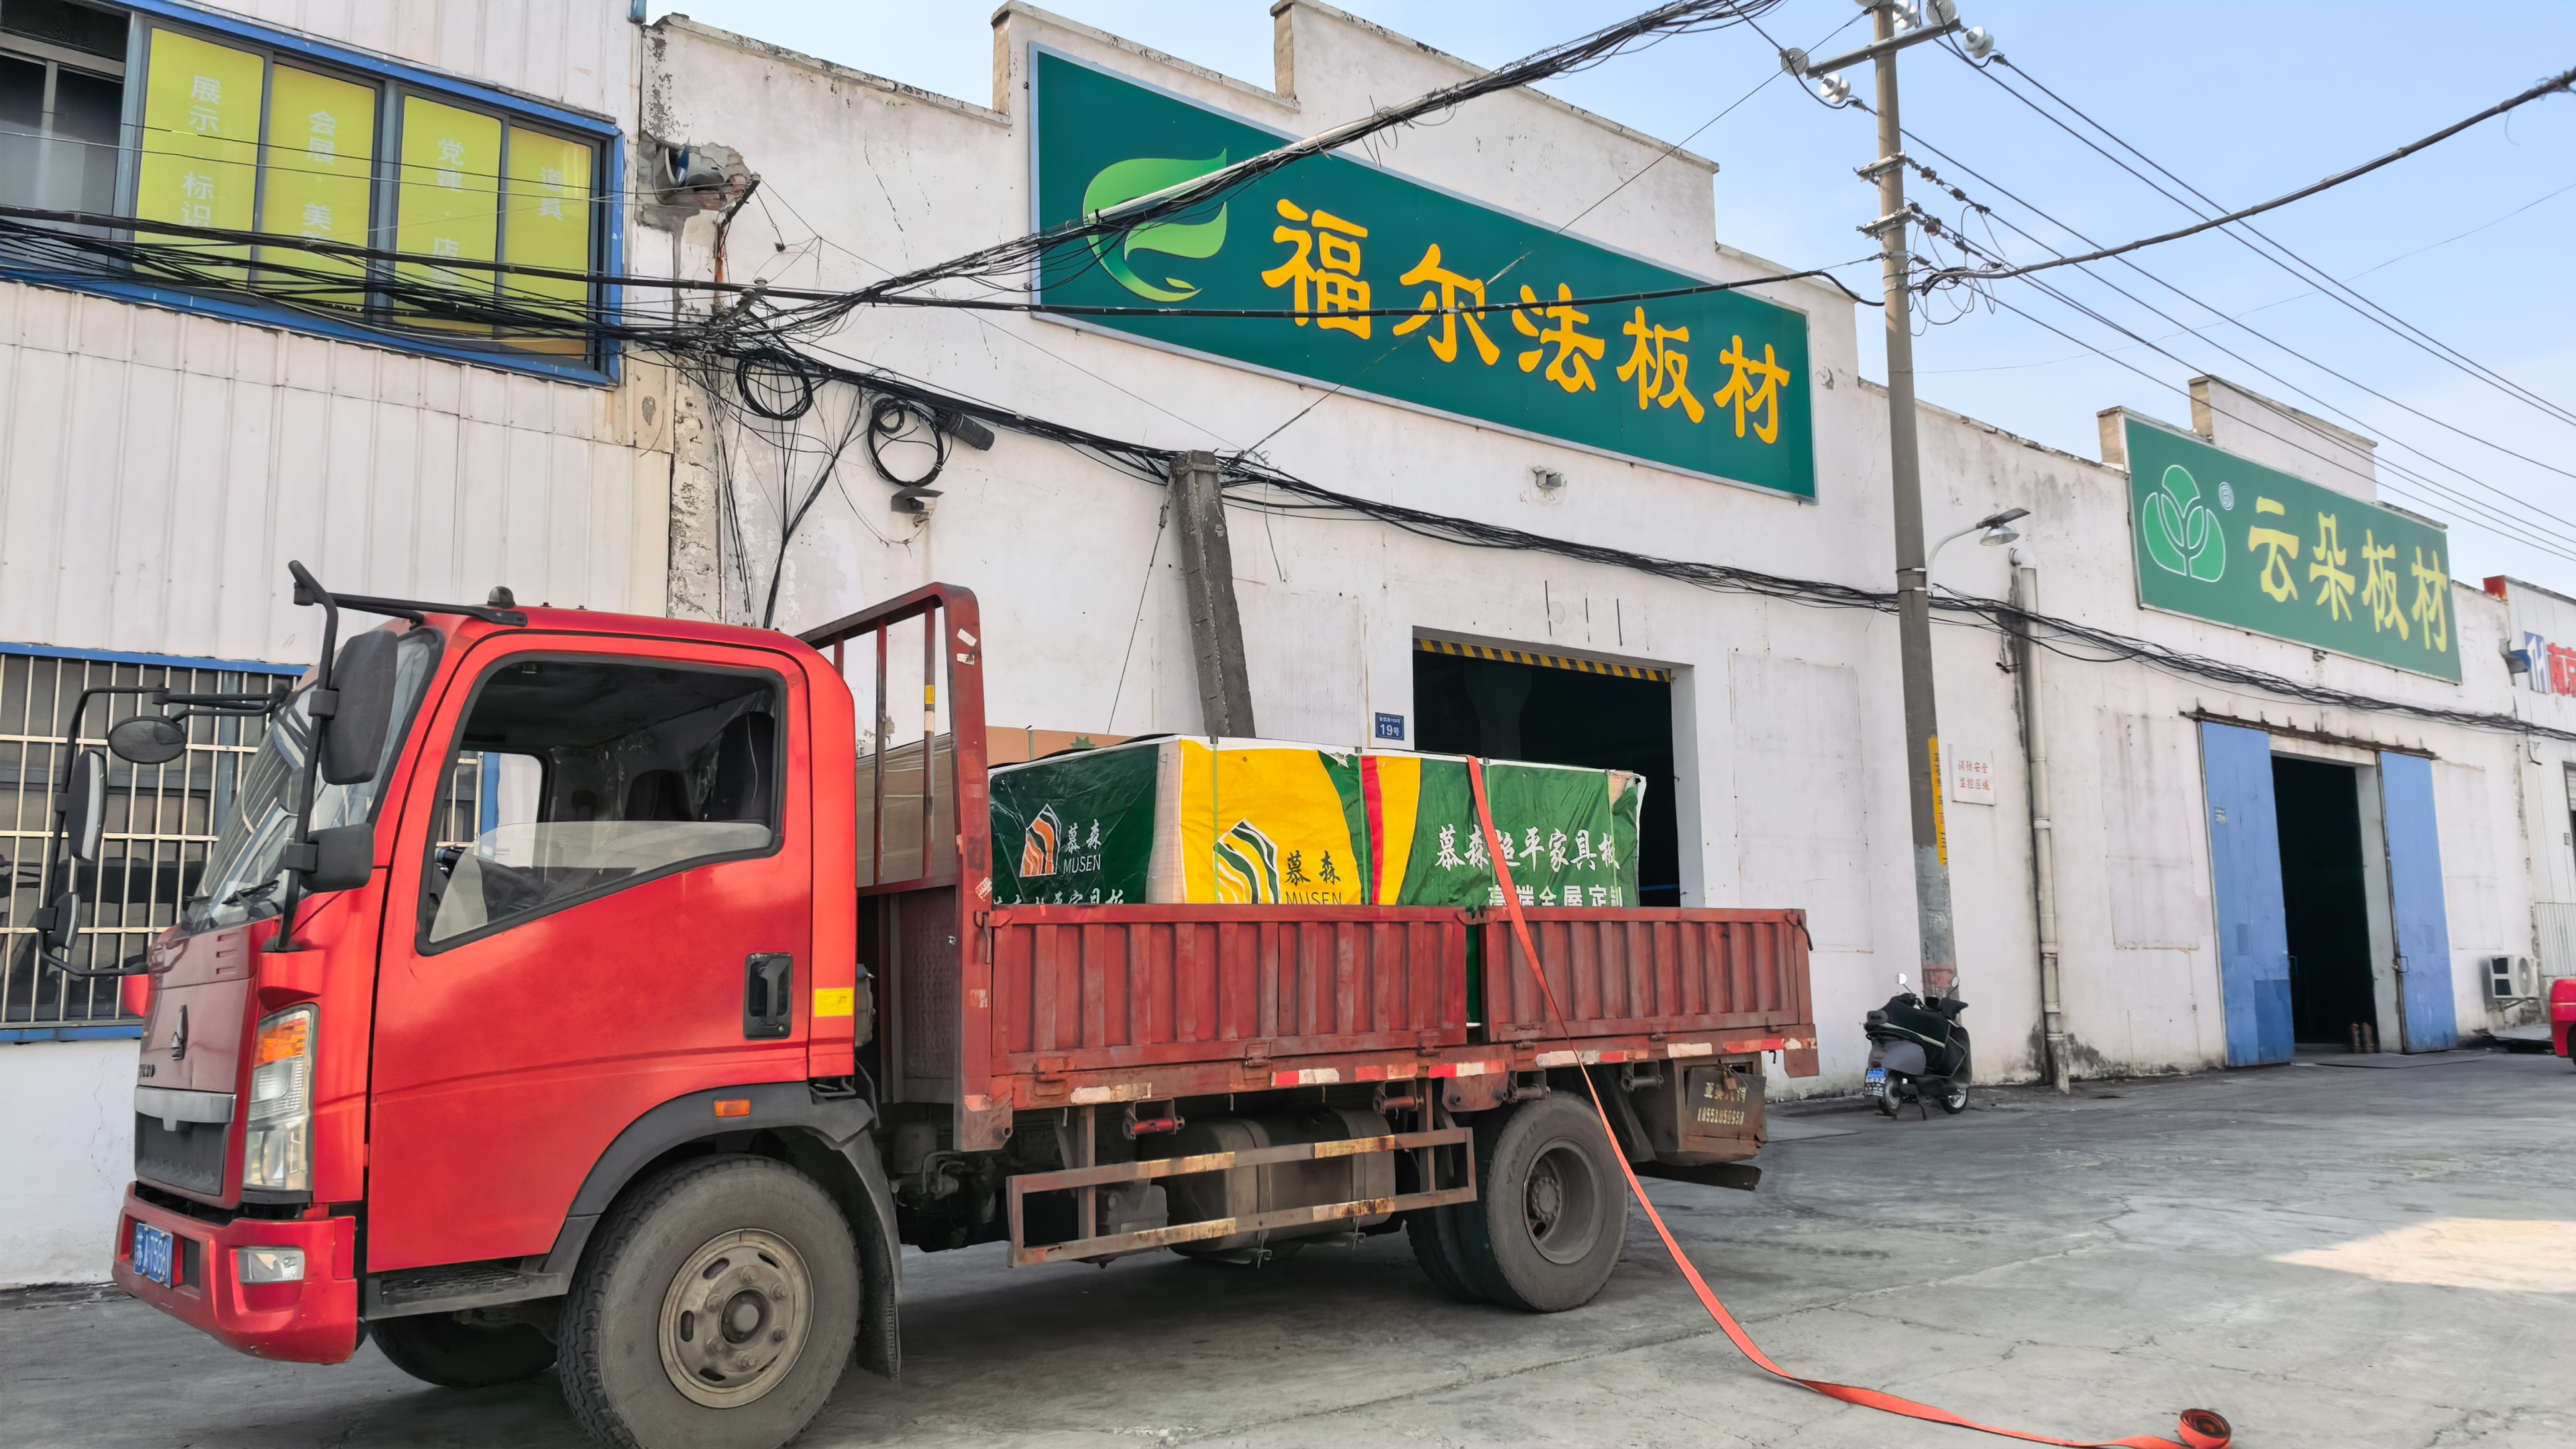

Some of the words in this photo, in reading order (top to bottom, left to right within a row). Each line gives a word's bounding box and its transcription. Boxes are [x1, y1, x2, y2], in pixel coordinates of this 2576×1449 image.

[1261, 199, 1790, 445] 福尔法板材
[2249, 496, 2447, 651] 云朵板材
[1380, 724, 1400, 737] 19号
[1957, 759, 1988, 773] 消防安全
[1960, 777, 1990, 791] 监控区域
[1065, 819, 1102, 854] 慕森
[1063, 854, 1102, 875] MUSEN
[1285, 849, 1342, 887] 慕森
